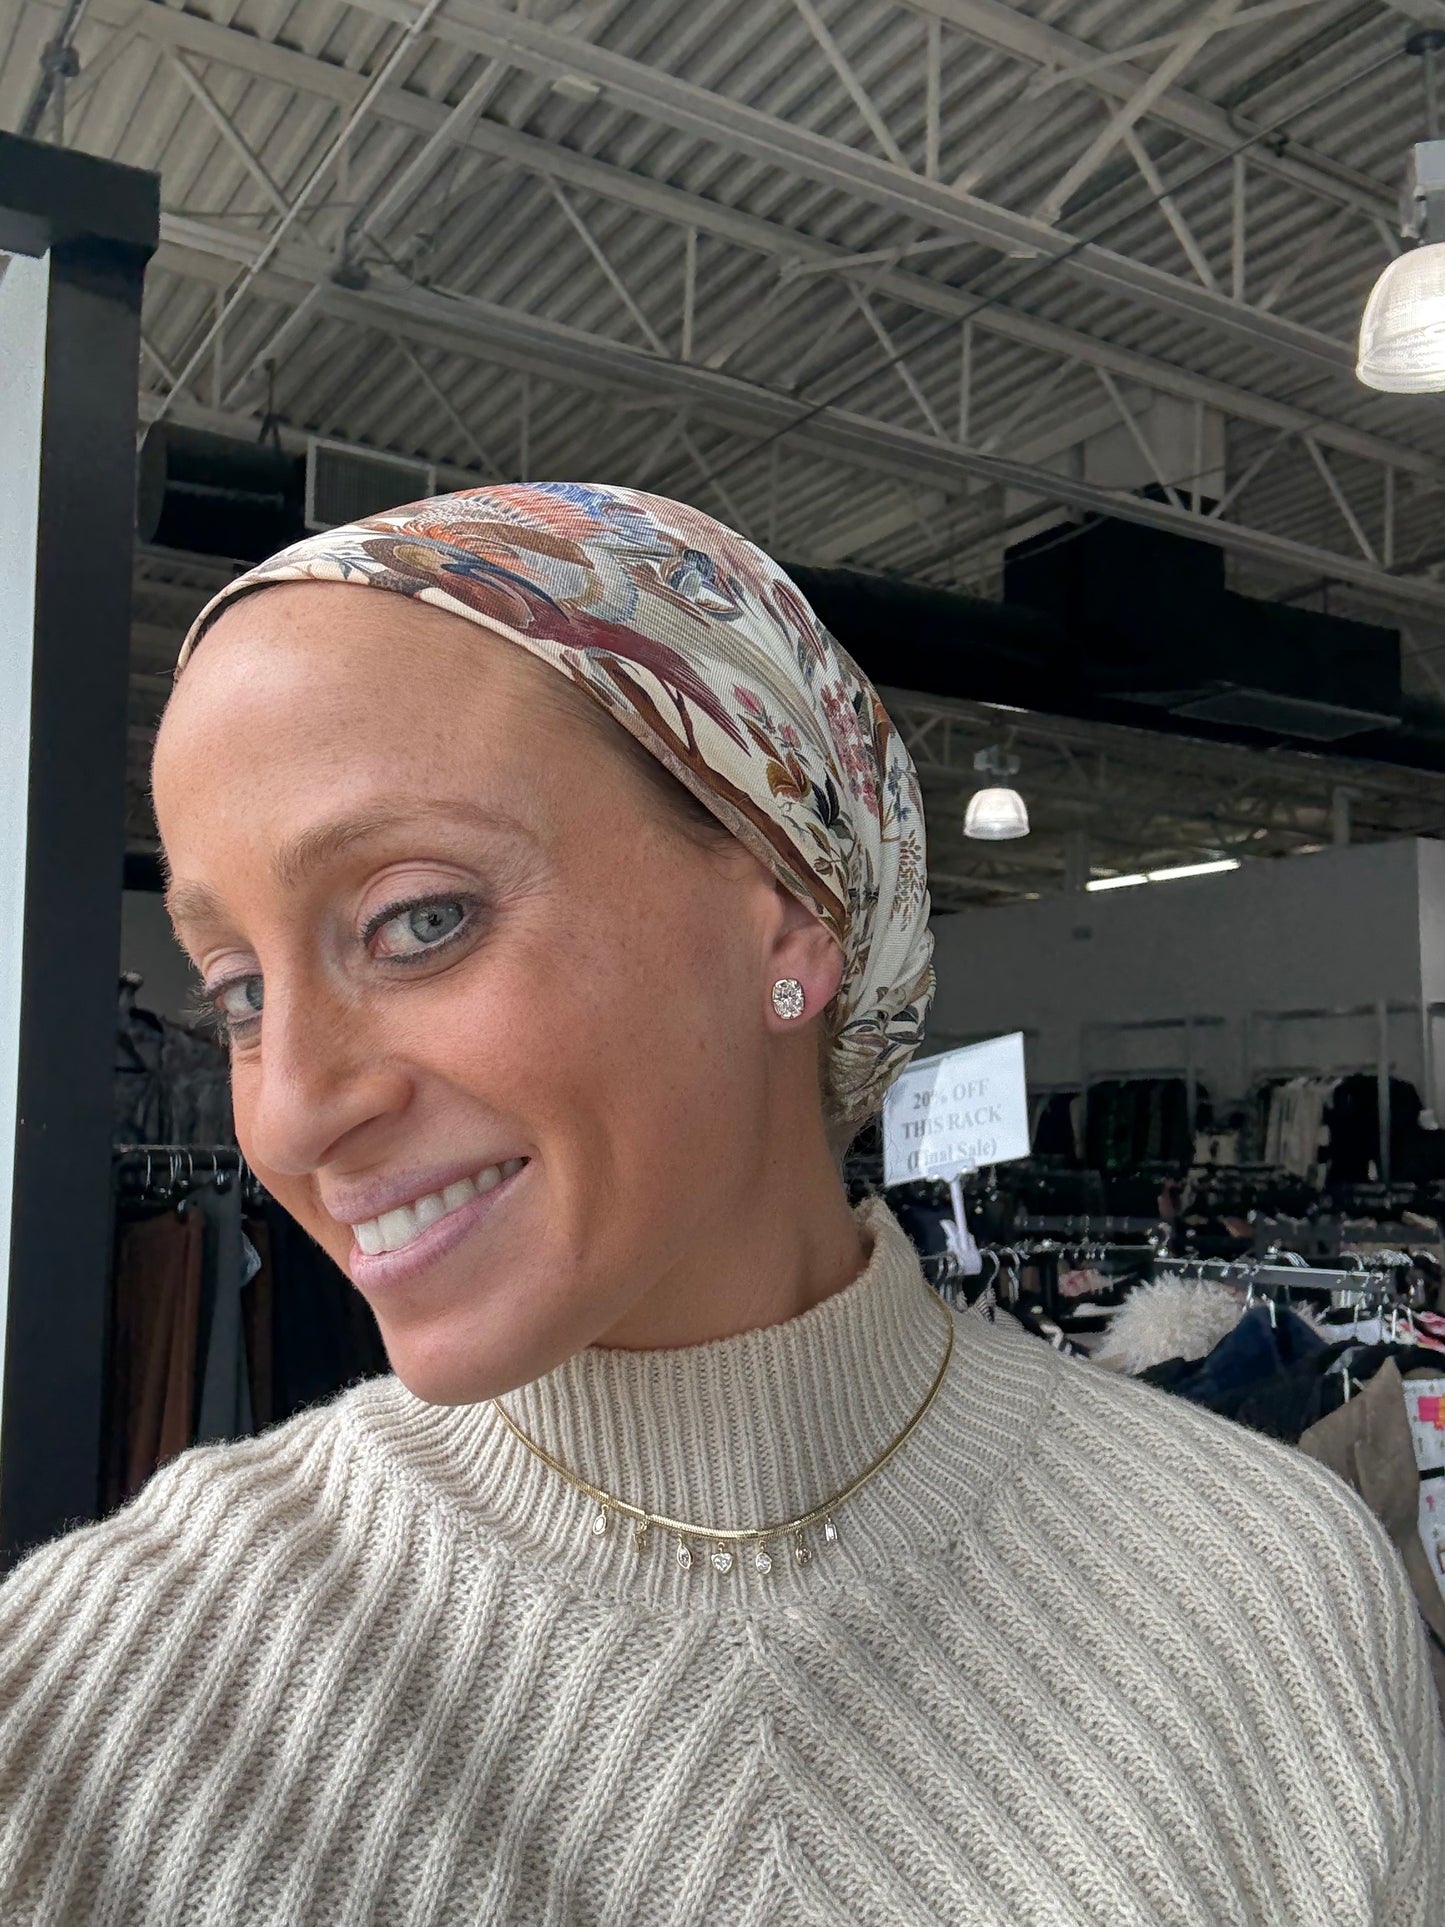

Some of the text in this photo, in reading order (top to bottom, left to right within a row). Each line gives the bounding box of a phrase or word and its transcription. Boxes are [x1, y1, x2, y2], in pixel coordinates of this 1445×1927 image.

[953, 1078, 990, 1101] OFF
[903, 1104, 1002, 1140] THIS RACK
[907, 1138, 997, 1172] (Final Sale)
